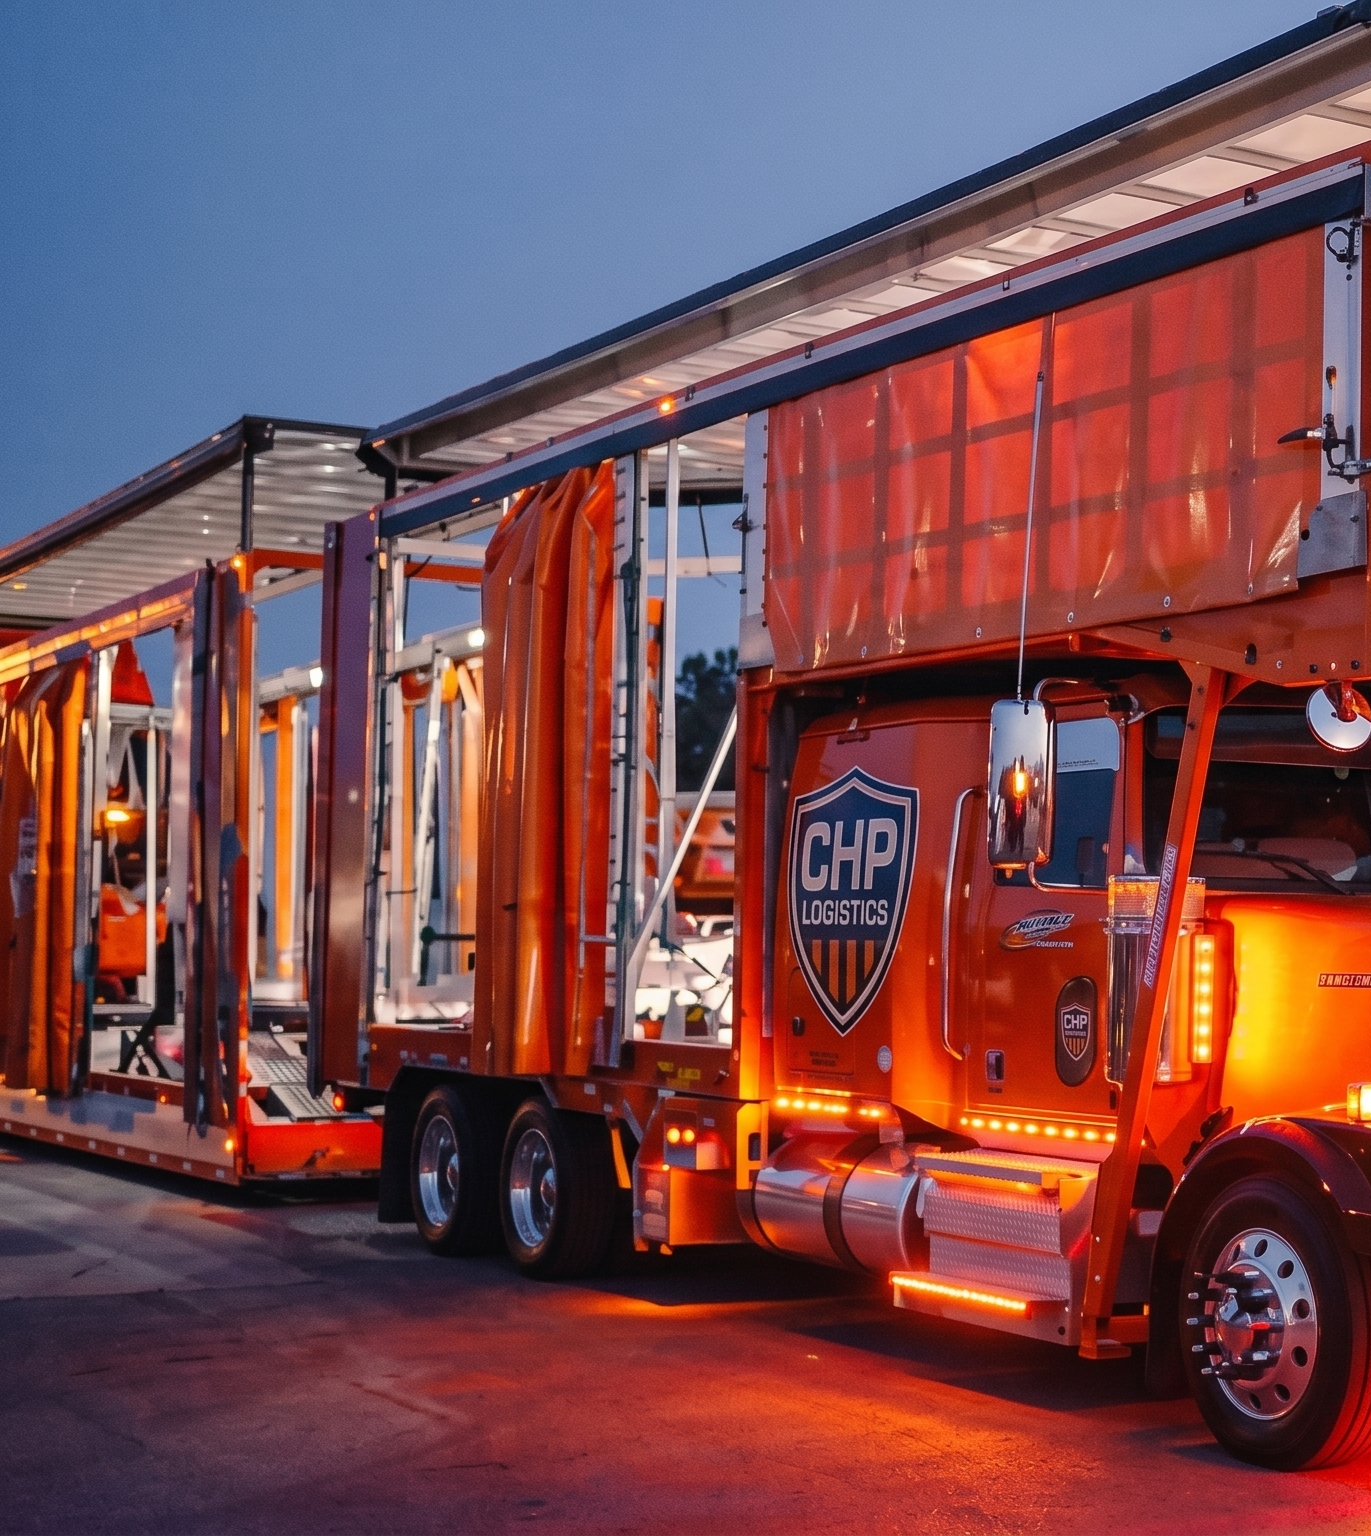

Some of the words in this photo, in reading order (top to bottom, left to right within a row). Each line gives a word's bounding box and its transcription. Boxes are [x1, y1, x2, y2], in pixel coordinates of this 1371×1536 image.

[801, 817, 898, 892] CHP
[801, 899, 888, 926] LOGISTICS
[1063, 1014, 1088, 1030] CHP
